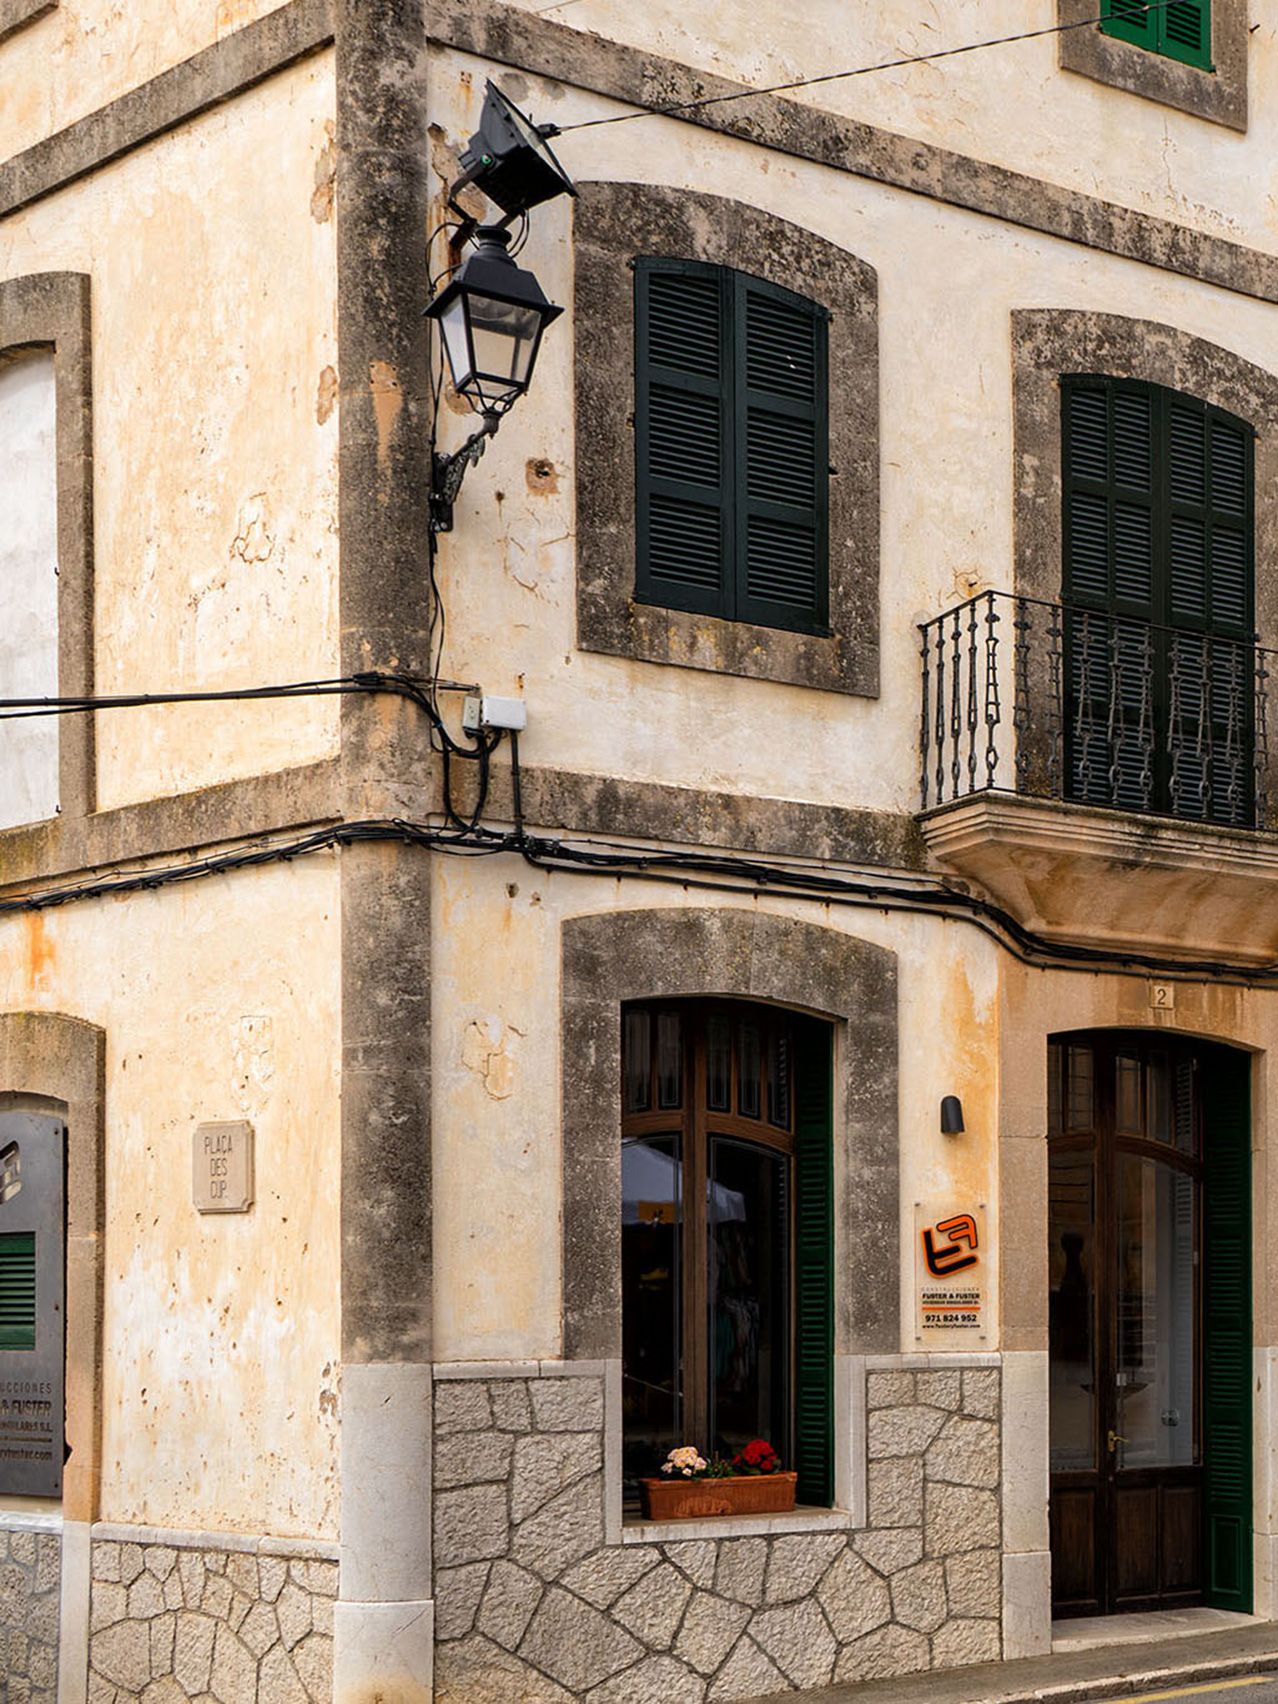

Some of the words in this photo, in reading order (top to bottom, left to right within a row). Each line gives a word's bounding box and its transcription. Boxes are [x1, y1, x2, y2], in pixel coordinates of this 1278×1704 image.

[1157, 988, 1167, 1006] 2
[203, 1134, 232, 1155] PLAÇA
[210, 1158, 228, 1177] DES
[925, 1314, 941, 1322] 971
[943, 1314, 959, 1322] 824
[960, 1314, 977, 1322] 952
[12, 1399, 52, 1416] FUSTER
